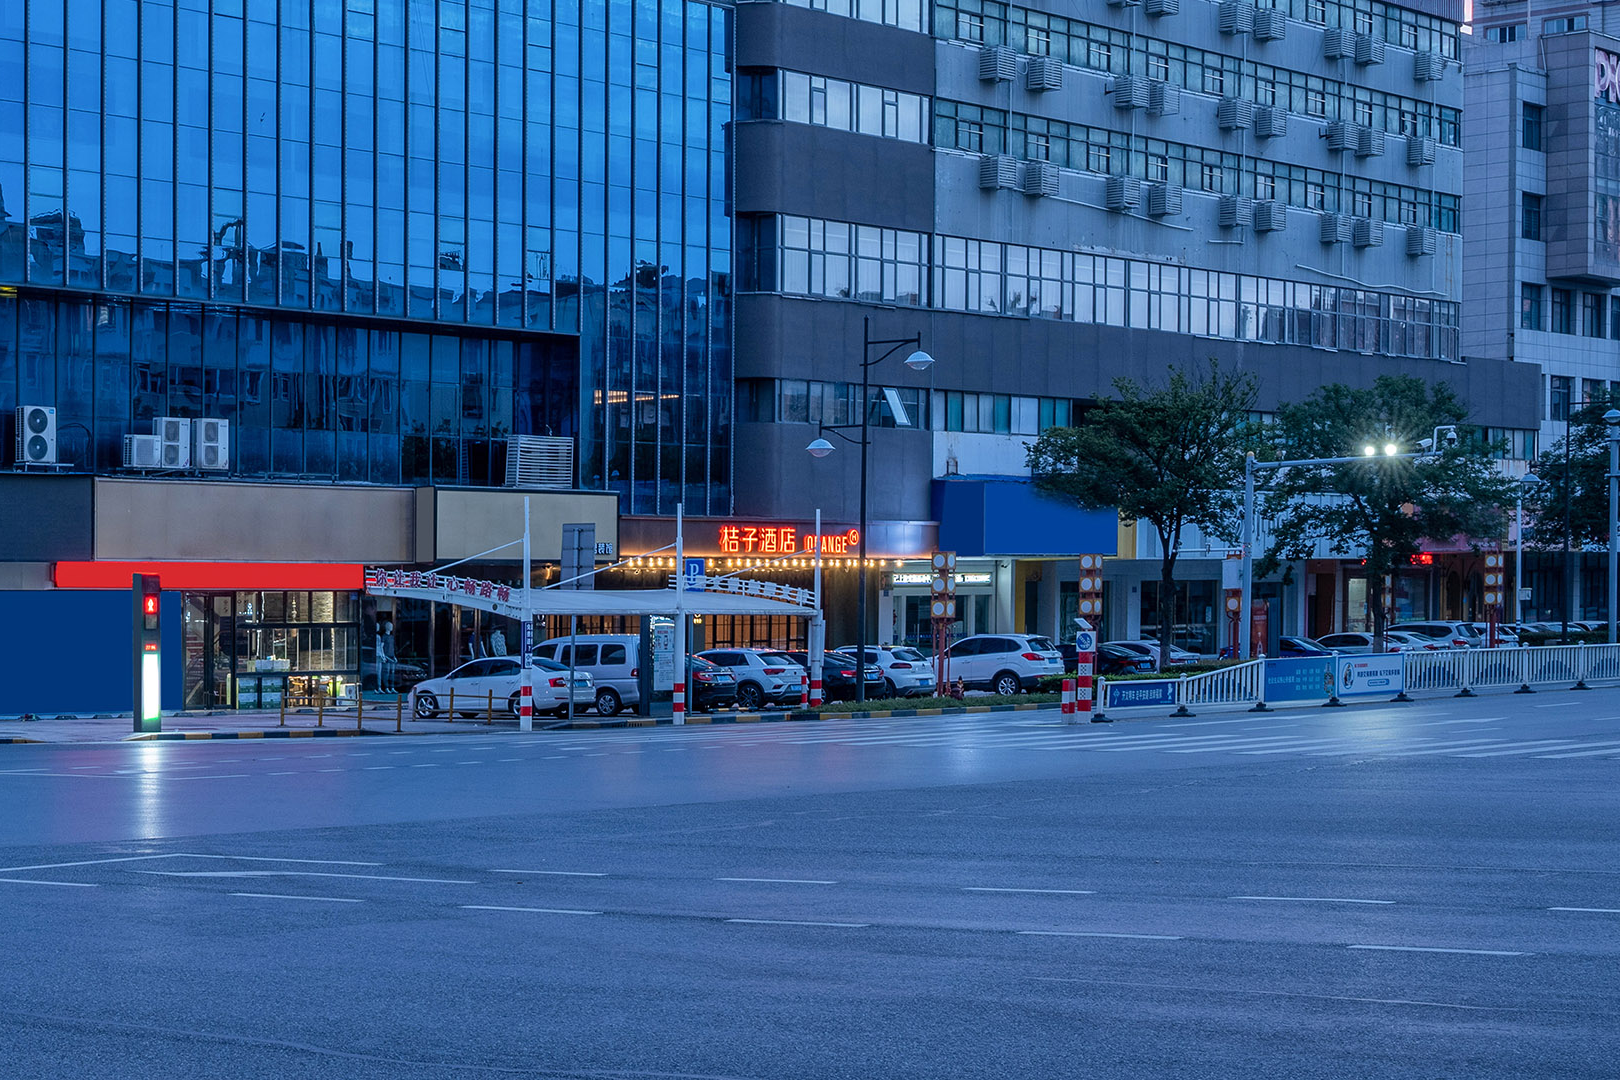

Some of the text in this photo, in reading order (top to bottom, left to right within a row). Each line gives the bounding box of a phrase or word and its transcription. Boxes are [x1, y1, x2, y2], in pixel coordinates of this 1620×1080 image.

[719, 525, 796, 553] 桔子酒店
[803, 535, 848, 553] OANGE
[375, 567, 512, 602] 你让我让心畅路畅
